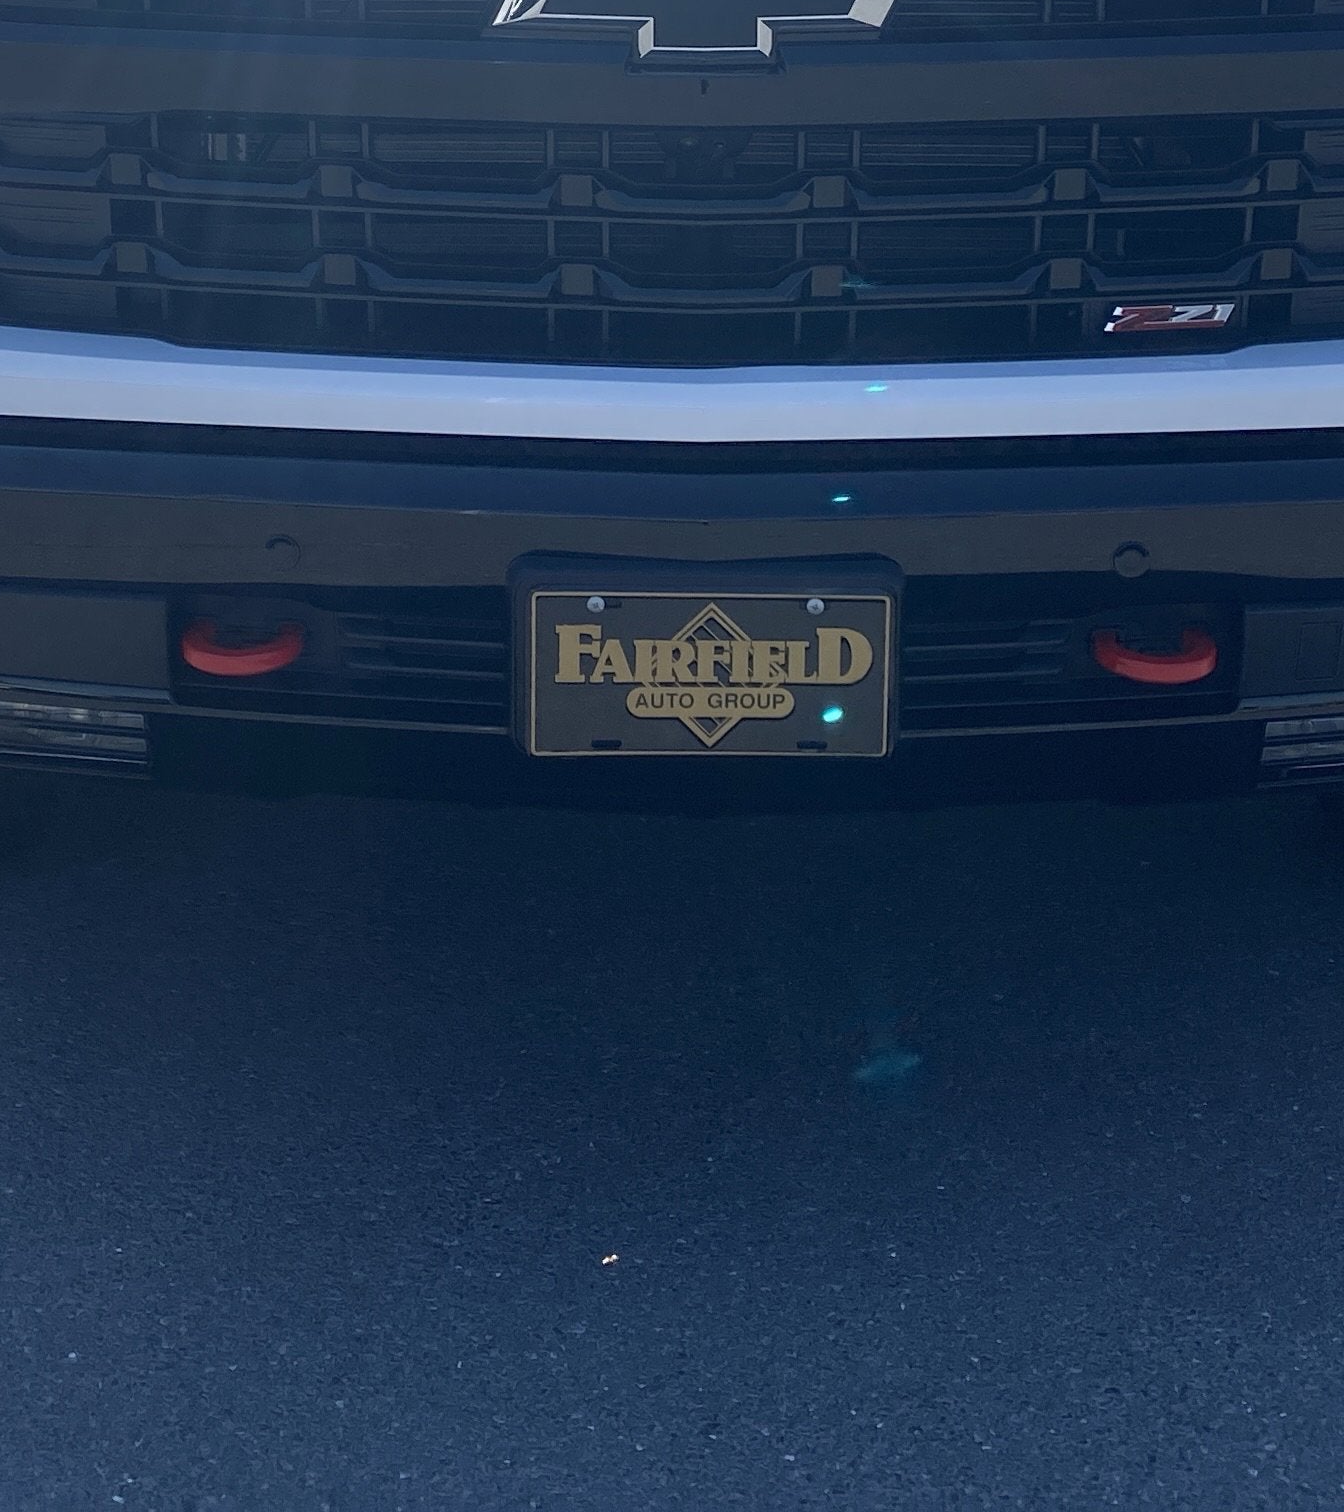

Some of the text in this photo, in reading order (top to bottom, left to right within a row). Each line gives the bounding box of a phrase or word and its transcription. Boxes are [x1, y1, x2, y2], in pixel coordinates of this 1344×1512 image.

[1104, 303, 1235, 332] Z71
[556, 624, 873, 684] FAIRFIELD
[635, 692, 787, 710] AUTO GROUP
